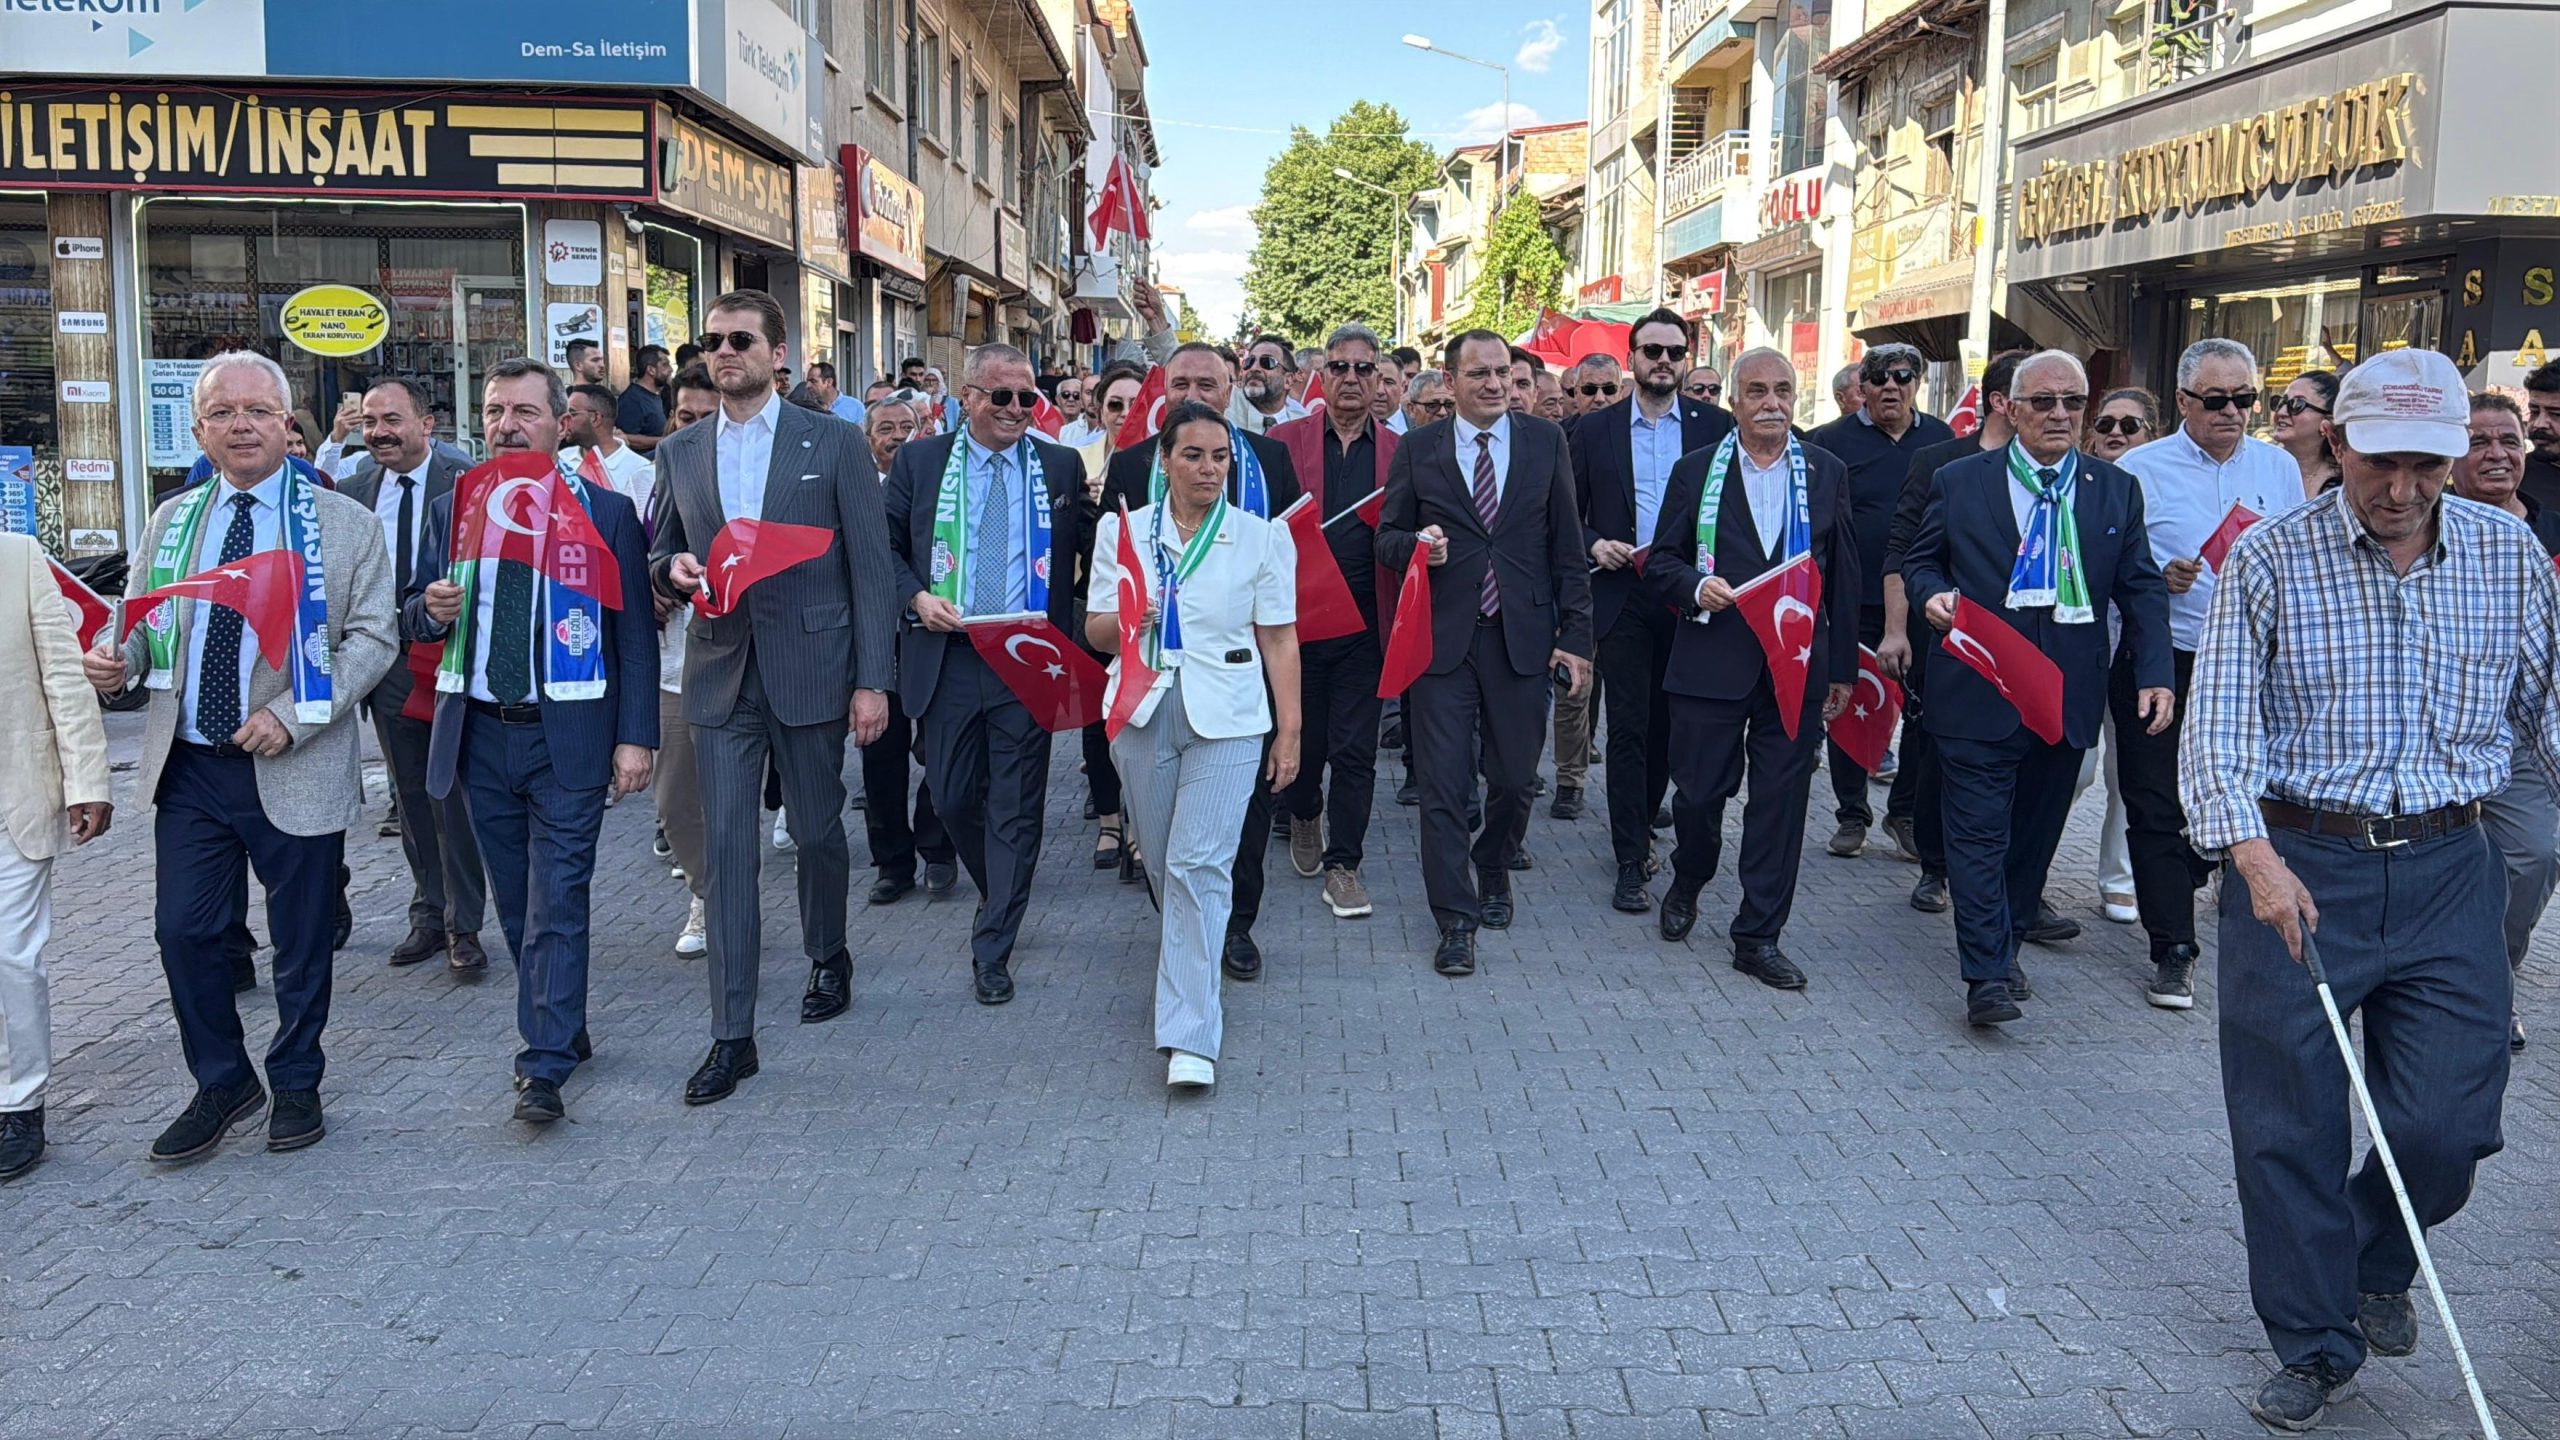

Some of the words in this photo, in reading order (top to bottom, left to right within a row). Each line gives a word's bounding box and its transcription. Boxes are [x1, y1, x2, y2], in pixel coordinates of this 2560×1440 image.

[521, 42, 596, 58] Dem-Sa
[600, 38, 667, 61] İletişim
[737, 30, 757, 69] Türk
[757, 45, 789, 93] Telekom
[2351, 197, 2405, 227] GÜZEL
[72, 242, 101, 253] iPhone
[570, 245, 598, 254] TEKNİK
[571, 253, 598, 261] SERVİS
[300, 307, 335, 318] HAYALET
[336, 308, 366, 318] EKRAN
[61, 318, 105, 327] SAMSUNG
[320, 322, 346, 331] NANO
[302, 331, 325, 340] EKRAN
[326, 331, 365, 340] KORUYUCU
[152, 369, 175, 377] Gelen
[154, 386, 166, 396] 50
[168, 386, 182, 396] GB
[70, 460, 110, 473] Redmi
[154, 485, 208, 569] EBER
[571, 633, 582, 655] EBER
